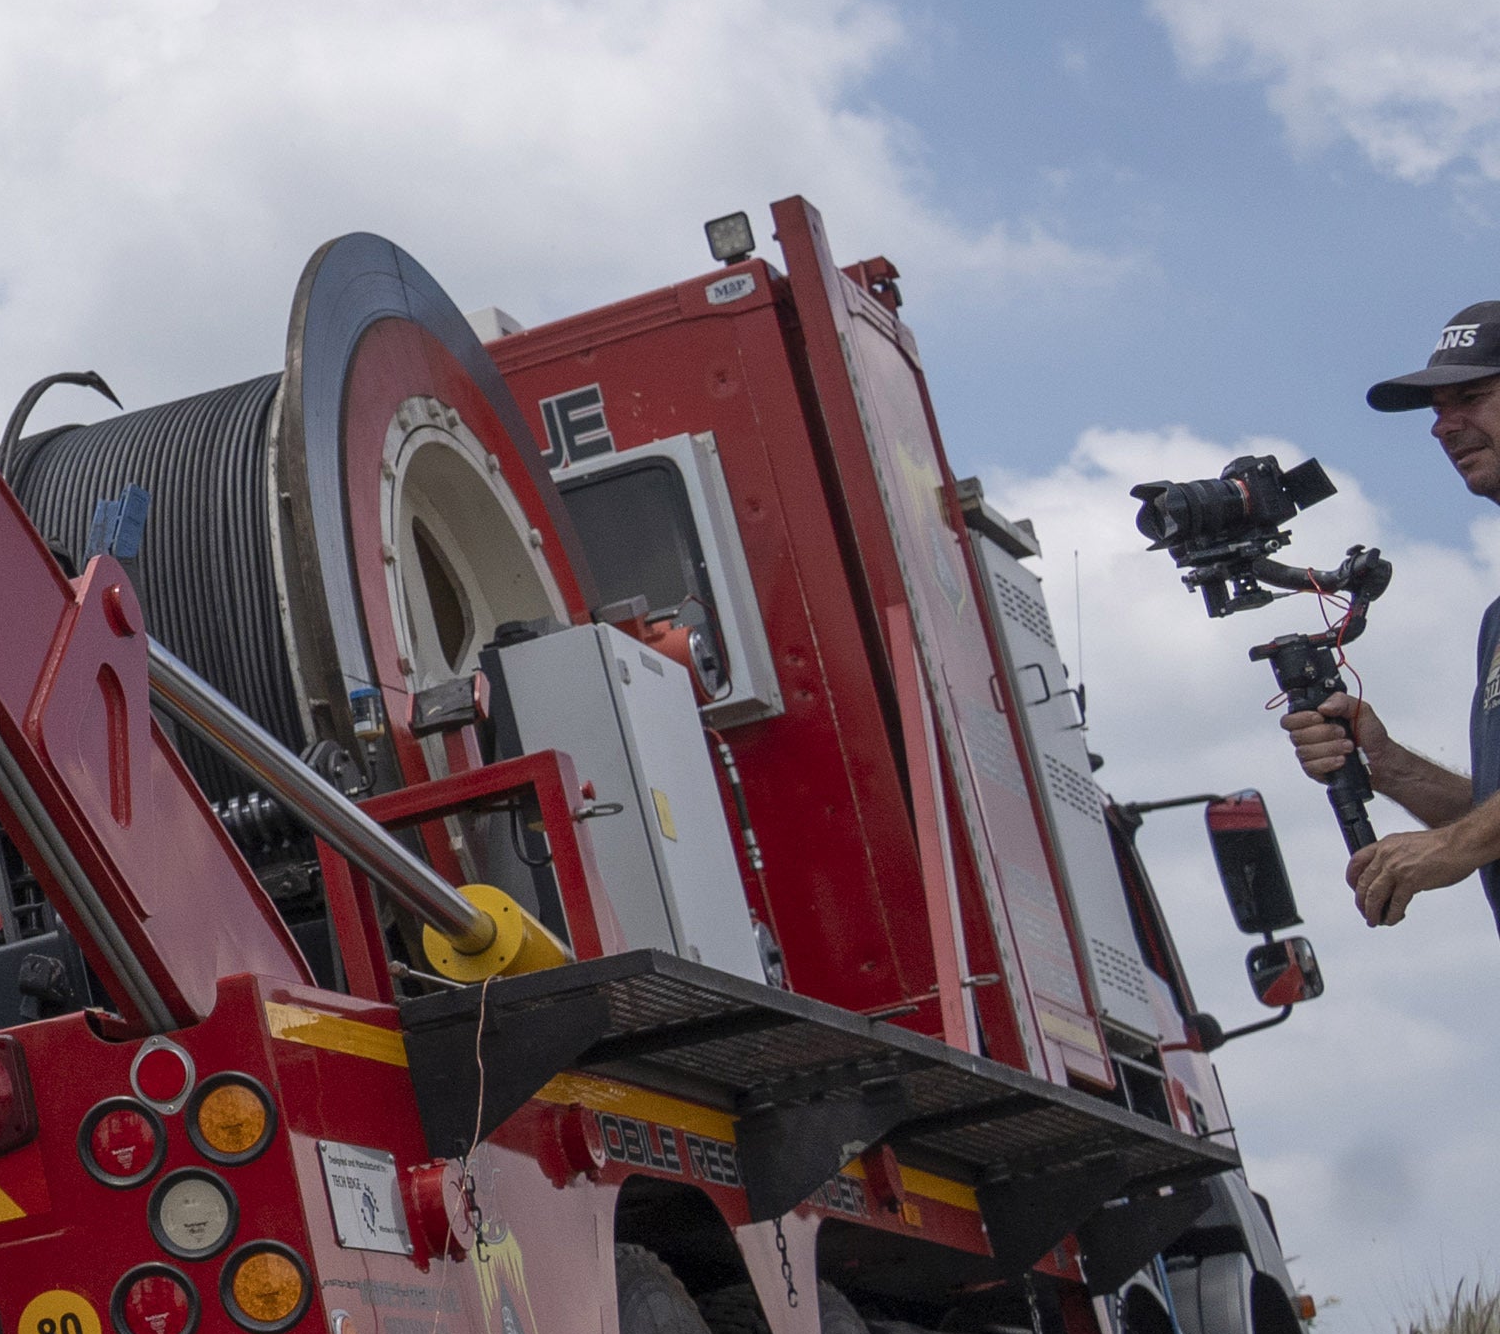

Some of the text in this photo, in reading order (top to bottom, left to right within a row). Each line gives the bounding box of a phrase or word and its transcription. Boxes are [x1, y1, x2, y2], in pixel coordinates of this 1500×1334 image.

[1434, 323, 1481, 353] ANS
[595, 1111, 684, 1175] OBILE
[332, 1174, 347, 1187] TECH
